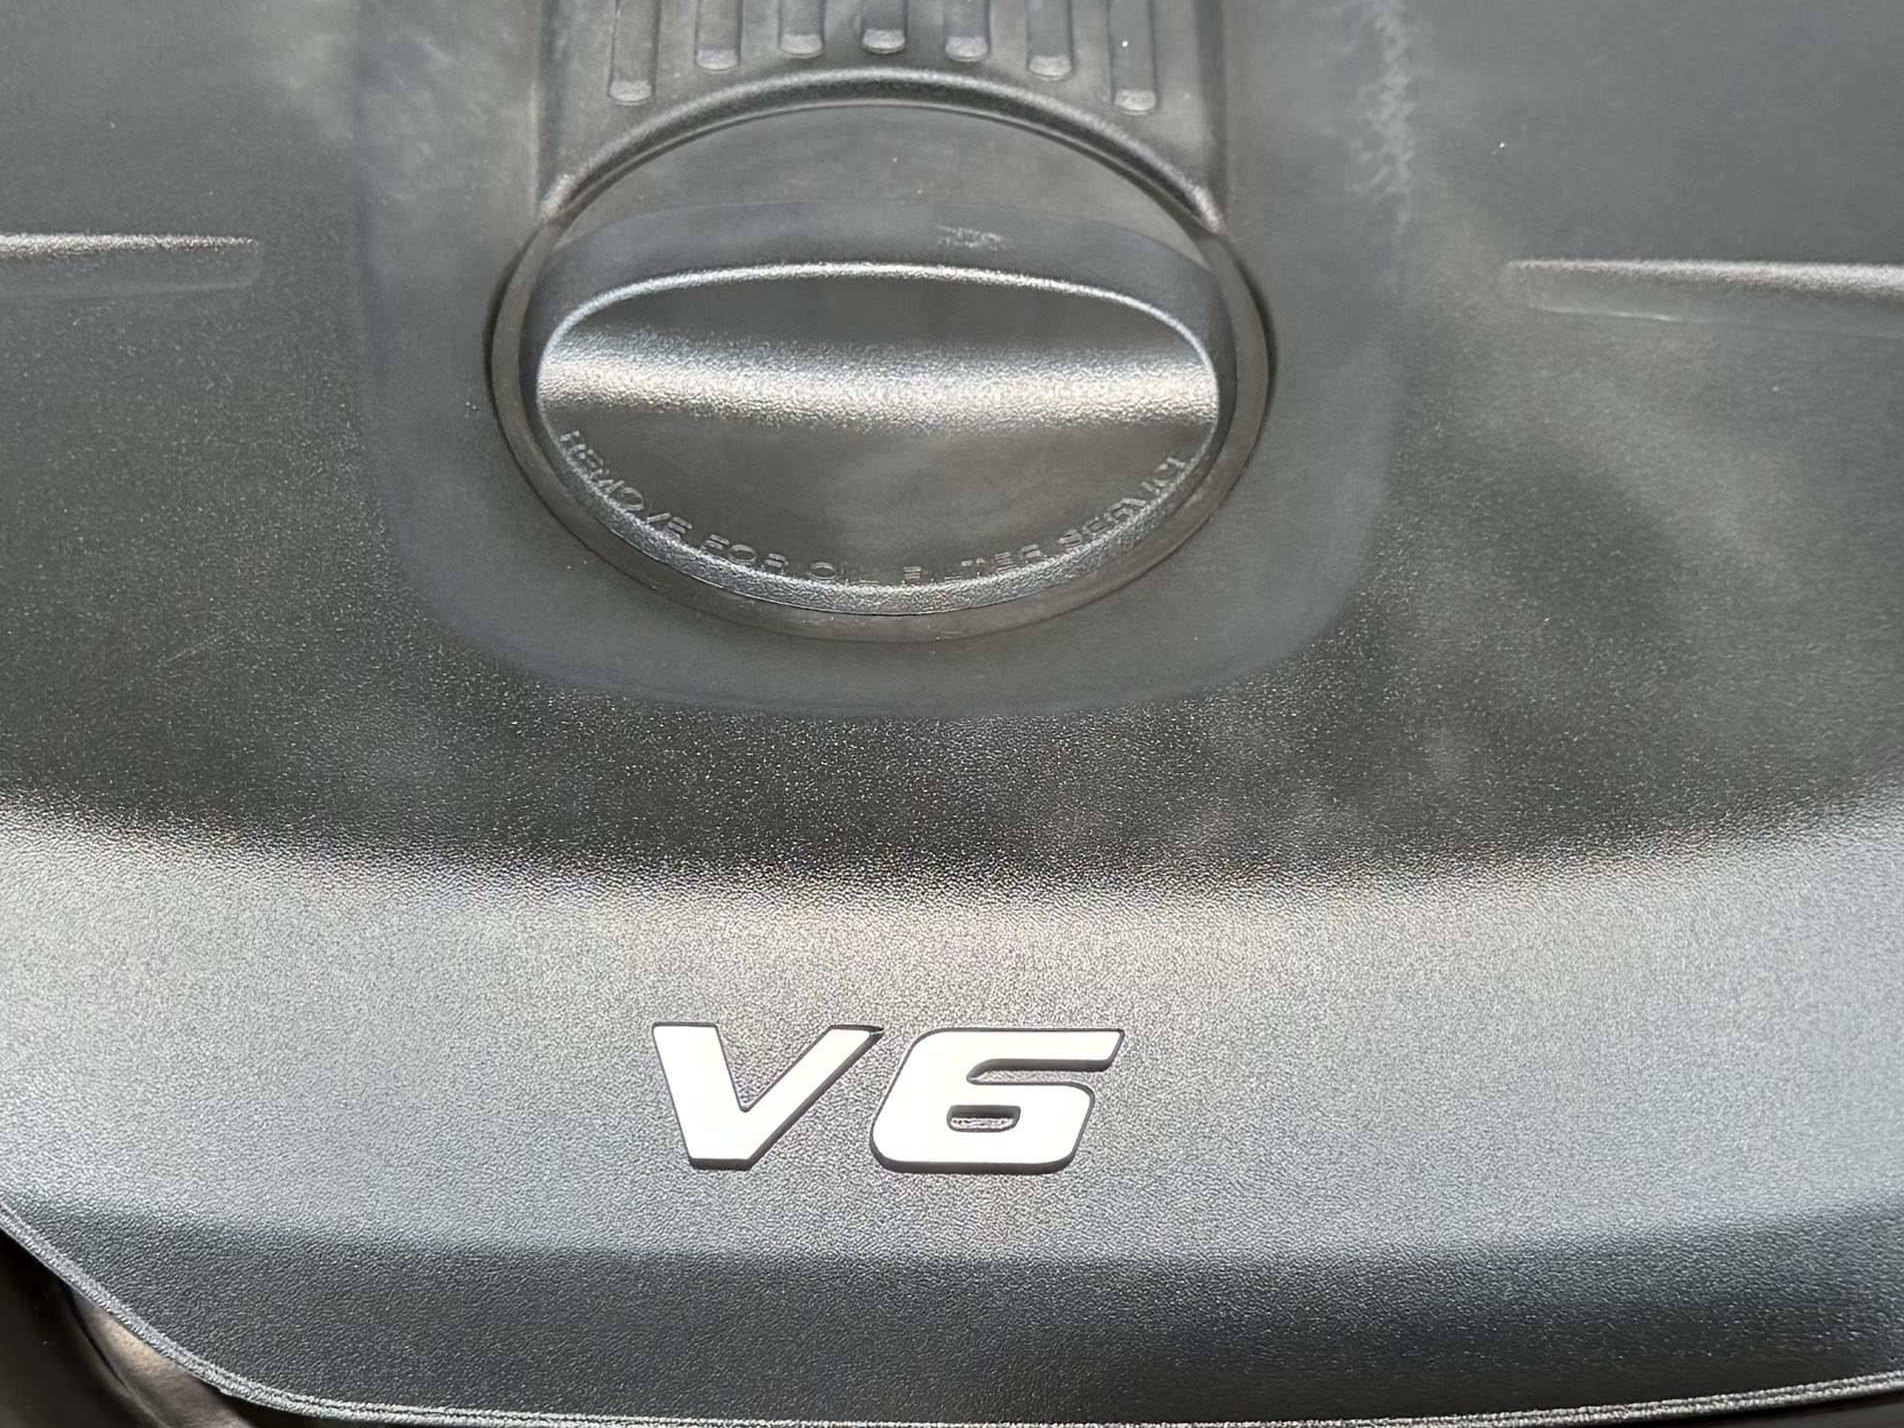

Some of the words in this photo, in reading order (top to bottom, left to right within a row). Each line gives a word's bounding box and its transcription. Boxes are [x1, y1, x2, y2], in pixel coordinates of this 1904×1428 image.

[557, 430, 694, 540] REMOVE
[698, 533, 790, 576] FOR
[652, 1021, 1125, 1174] V6
